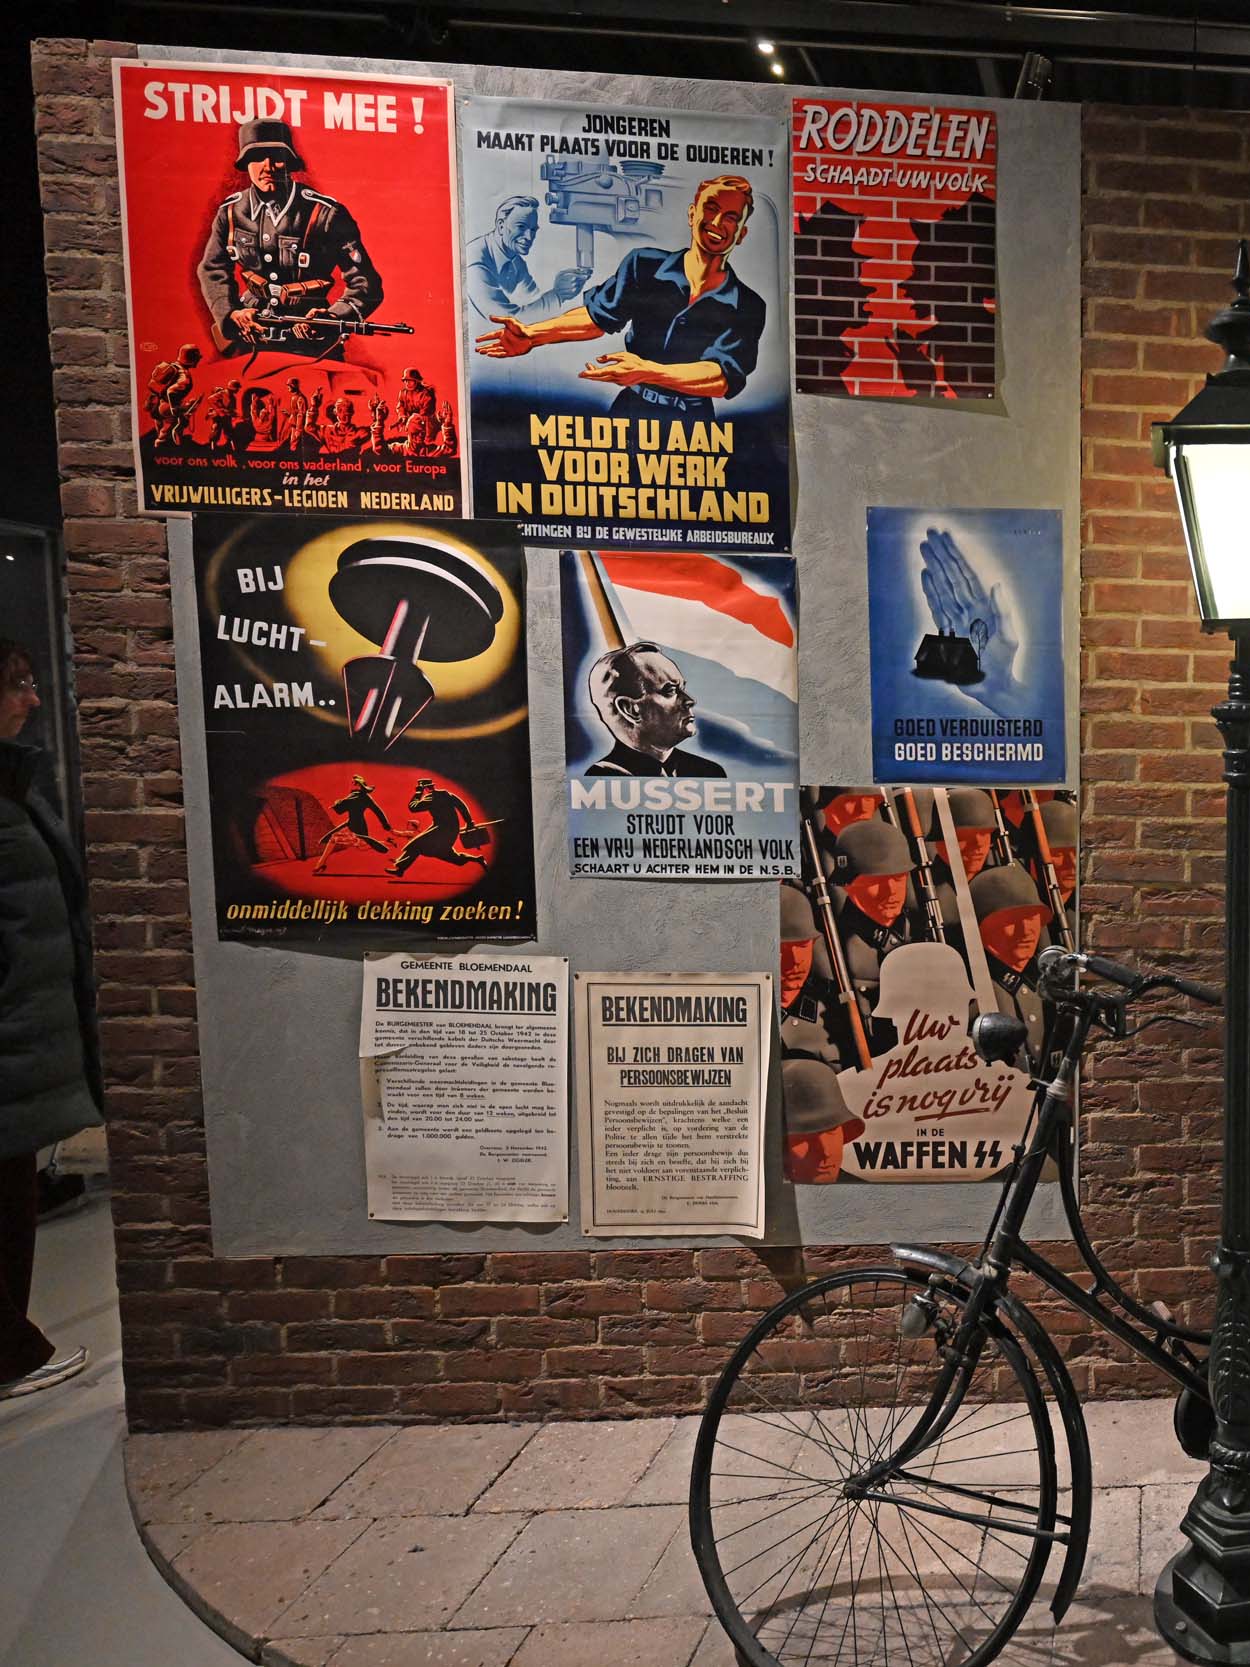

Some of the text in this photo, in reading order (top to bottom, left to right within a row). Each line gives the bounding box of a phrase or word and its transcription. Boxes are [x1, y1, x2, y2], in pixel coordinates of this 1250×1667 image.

[144, 82, 308, 127] STRIJDT
[323, 91, 397, 133] MEE
[582, 114, 671, 138] JONGEREN
[800, 104, 990, 160] RODDELEN
[477, 130, 535, 151] MAAKT
[540, 135, 600, 157] PLAATS
[606, 139, 651, 159] VOOR
[657, 142, 679, 161] DE
[686, 144, 764, 167] OUDEREN
[804, 163, 988, 193] SCHAADT UW VOLK
[530, 413, 734, 454] MELDT U AAN
[155, 455, 447, 480] voor ons volk voor ons vaderland voor Europa
[282, 472, 331, 486] in het
[538, 449, 729, 487] VOOR WERK
[151, 484, 454, 512] VRIJWILLIGERS-LEGIOEN NEDERLAND
[496, 481, 770, 524] IN DUITSCHLAND
[520, 524, 775, 545] HTINGEN BIJ DE GEWESTELIJKE ARBEIDSBUREAUX
[237, 565, 284, 594] BIJ
[216, 614, 327, 652] LUCHT-
[214, 682, 336, 709] ALARM..
[894, 718, 1043, 737] GOED VERDUISTERD
[895, 743, 1043, 761] GOED BESCHERMD
[570, 779, 794, 812] MUSSERT
[627, 814, 735, 835] STRIJDT VOOR
[574, 838, 795, 860] EEN VRIJ NEDERLANDSCH VOLK
[574, 863, 797, 875] SCHAART U ACHTER HEM IN DE N.S.B.
[227, 900, 524, 925] onmiddellijk dekking zoeken!
[401, 961, 533, 973] GEMEENTE BLOEMENDAAL
[376, 978, 557, 1012] BEKENDMAKING
[602, 996, 747, 1023] BEKENDMAKING
[903, 1009, 960, 1046] Uw
[607, 1047, 744, 1063] BIJ ZICH DRAGEN VAN
[877, 1046, 978, 1089] plaats
[620, 1069, 732, 1086] PERSOONSBEWIJZEN
[863, 1075, 1015, 1120] is nog vrij
[916, 1128, 945, 1137] IN DE
[853, 1141, 968, 1170] WAFFEN
